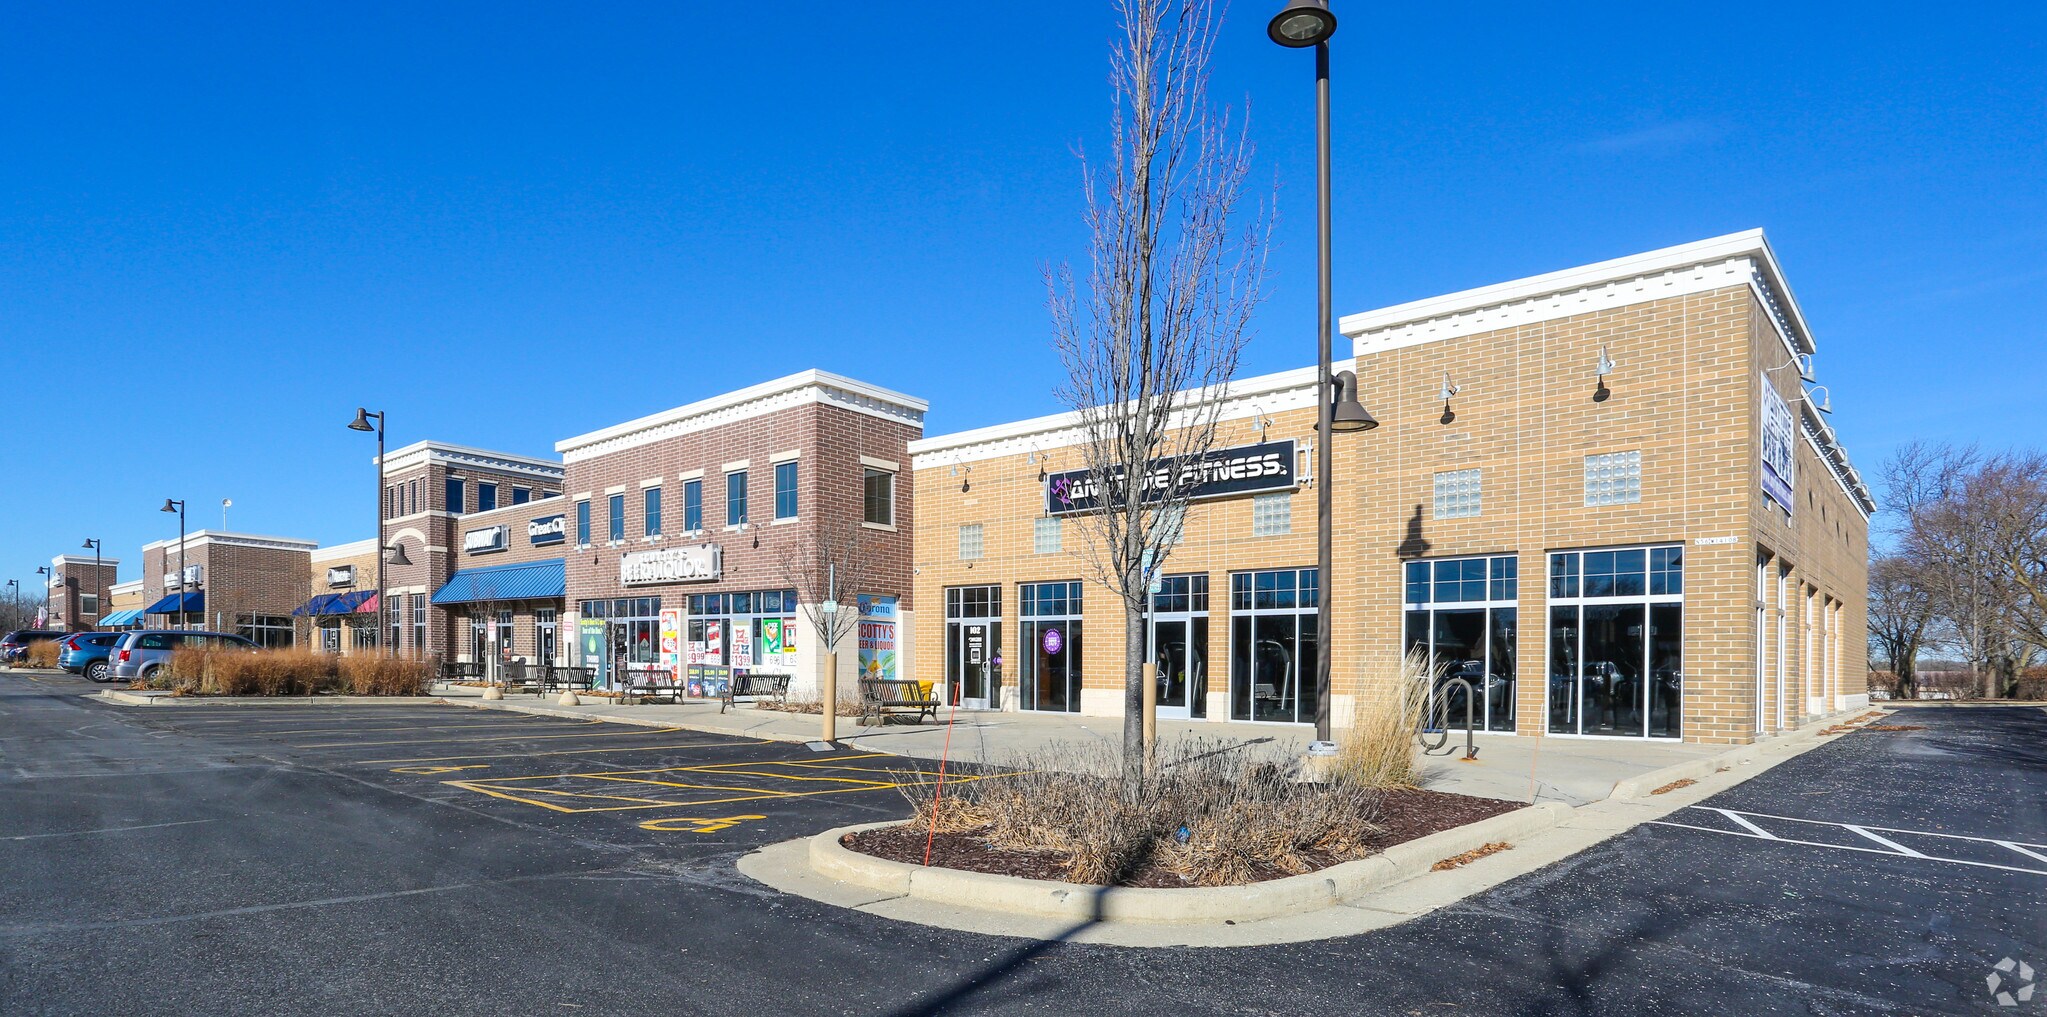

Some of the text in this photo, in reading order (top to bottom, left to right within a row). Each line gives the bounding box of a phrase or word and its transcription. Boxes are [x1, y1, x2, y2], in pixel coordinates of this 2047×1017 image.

[528, 522, 552, 536] Great
[464, 526, 500, 549] SUBWAY
[621, 563, 647, 582] BEER
[654, 559, 706, 580] LIQUOR
[860, 602, 890, 615] Corona
[970, 627, 981, 635] 102
[859, 641, 869, 649] EER
